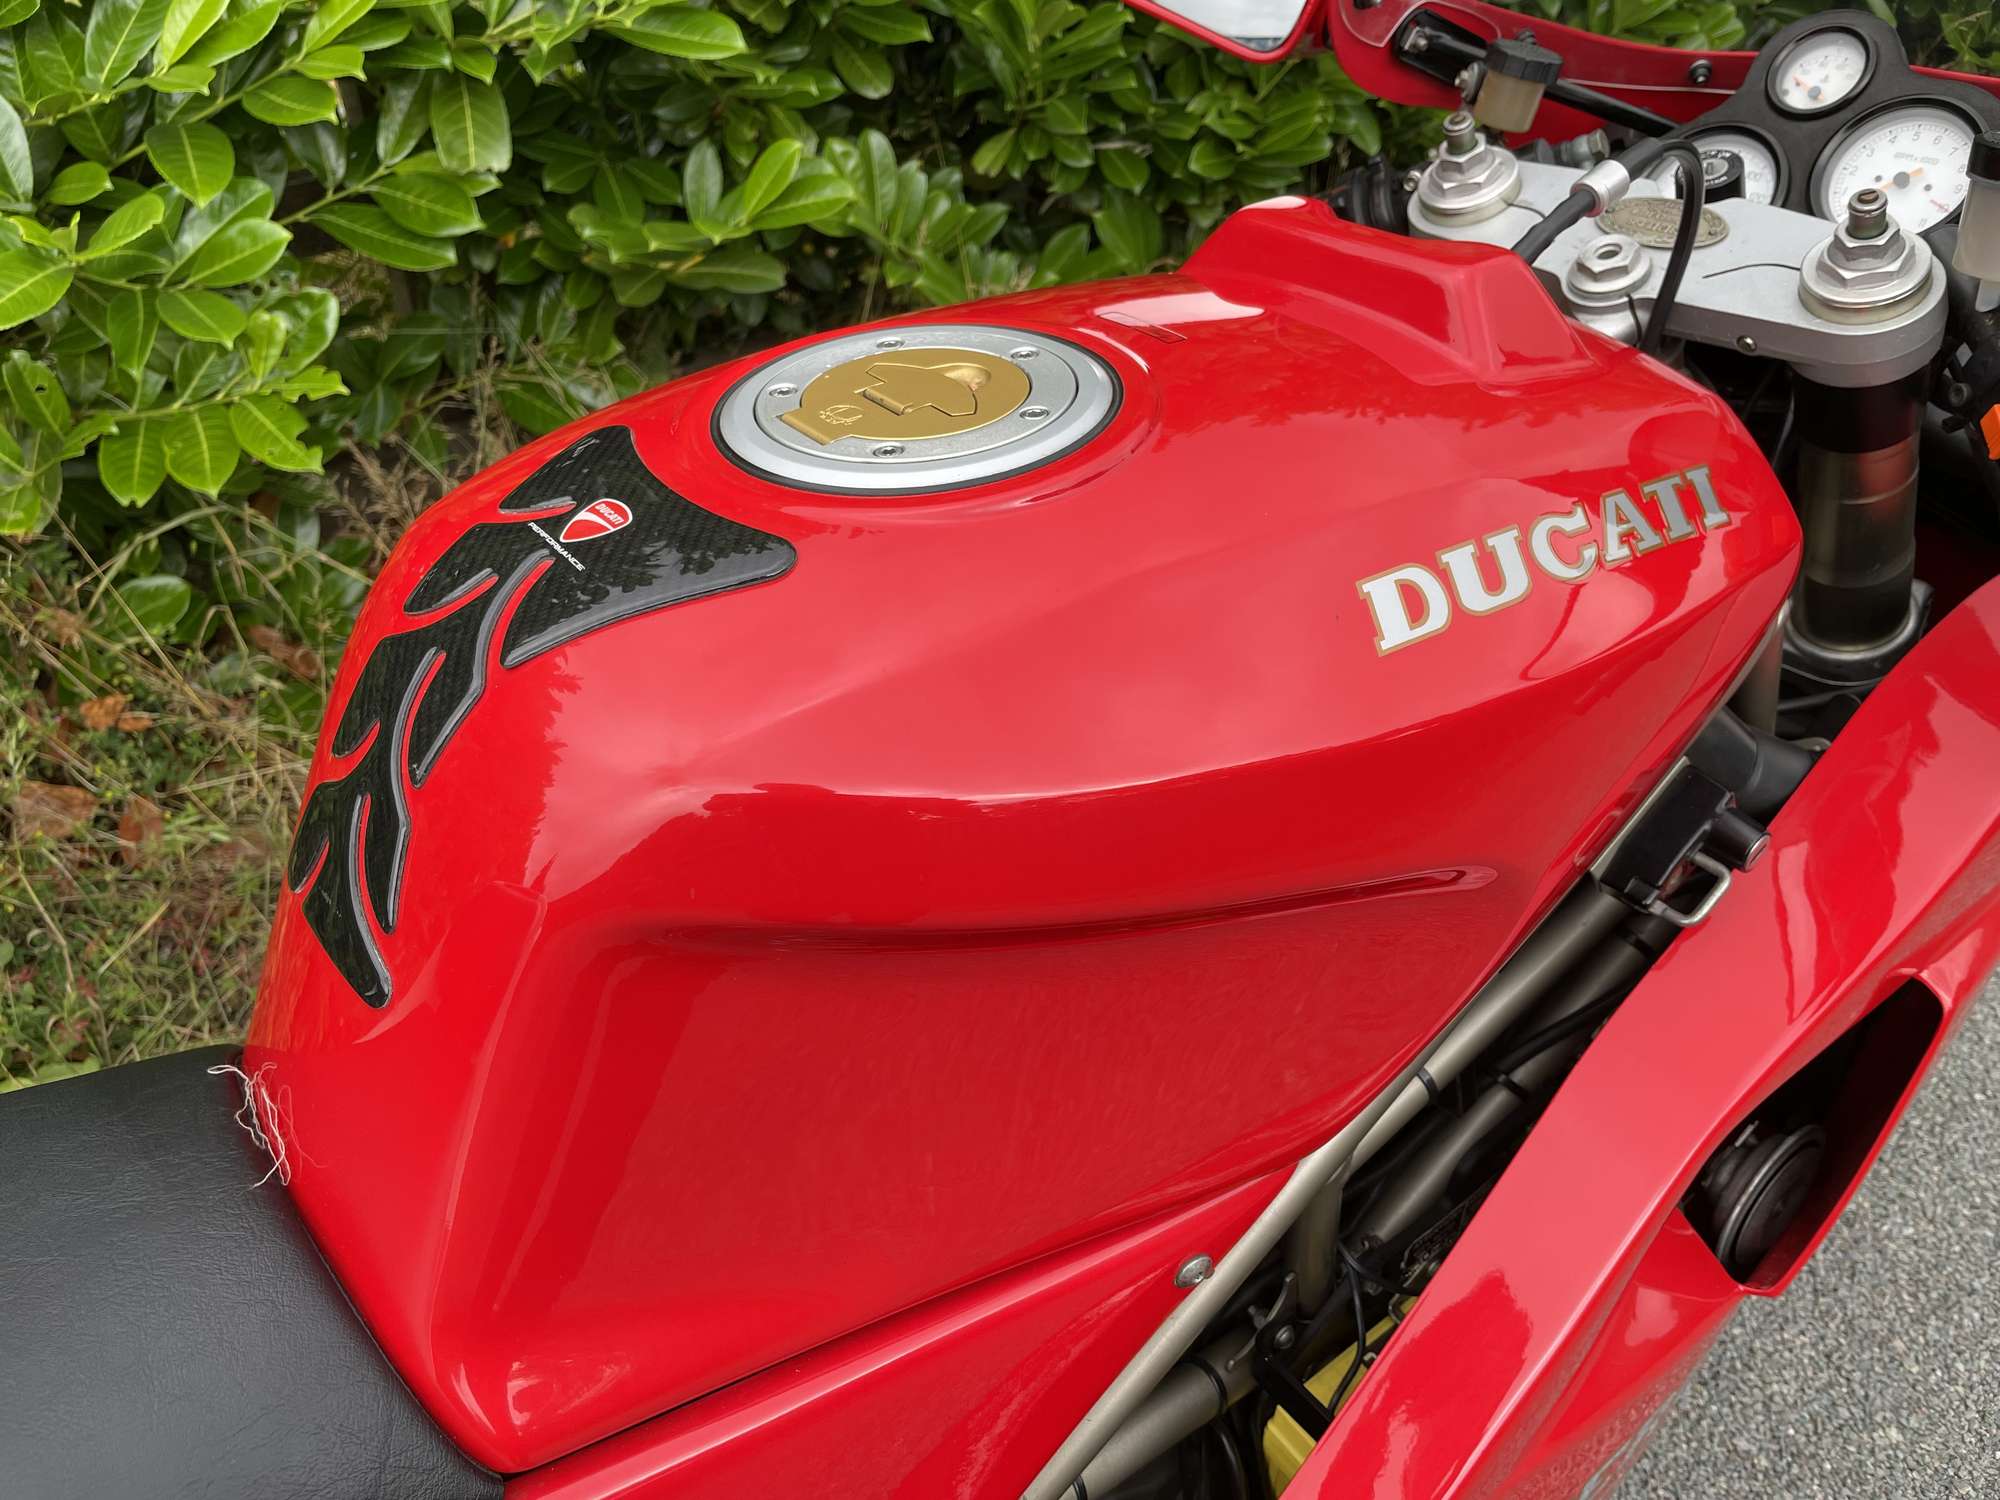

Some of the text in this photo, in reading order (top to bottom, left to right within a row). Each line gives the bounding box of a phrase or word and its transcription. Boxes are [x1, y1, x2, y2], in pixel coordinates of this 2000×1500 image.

[594, 503, 625, 525] DUCATI
[527, 521, 586, 572] PERFORMANCE
[1355, 463, 1732, 657] DUCATI
